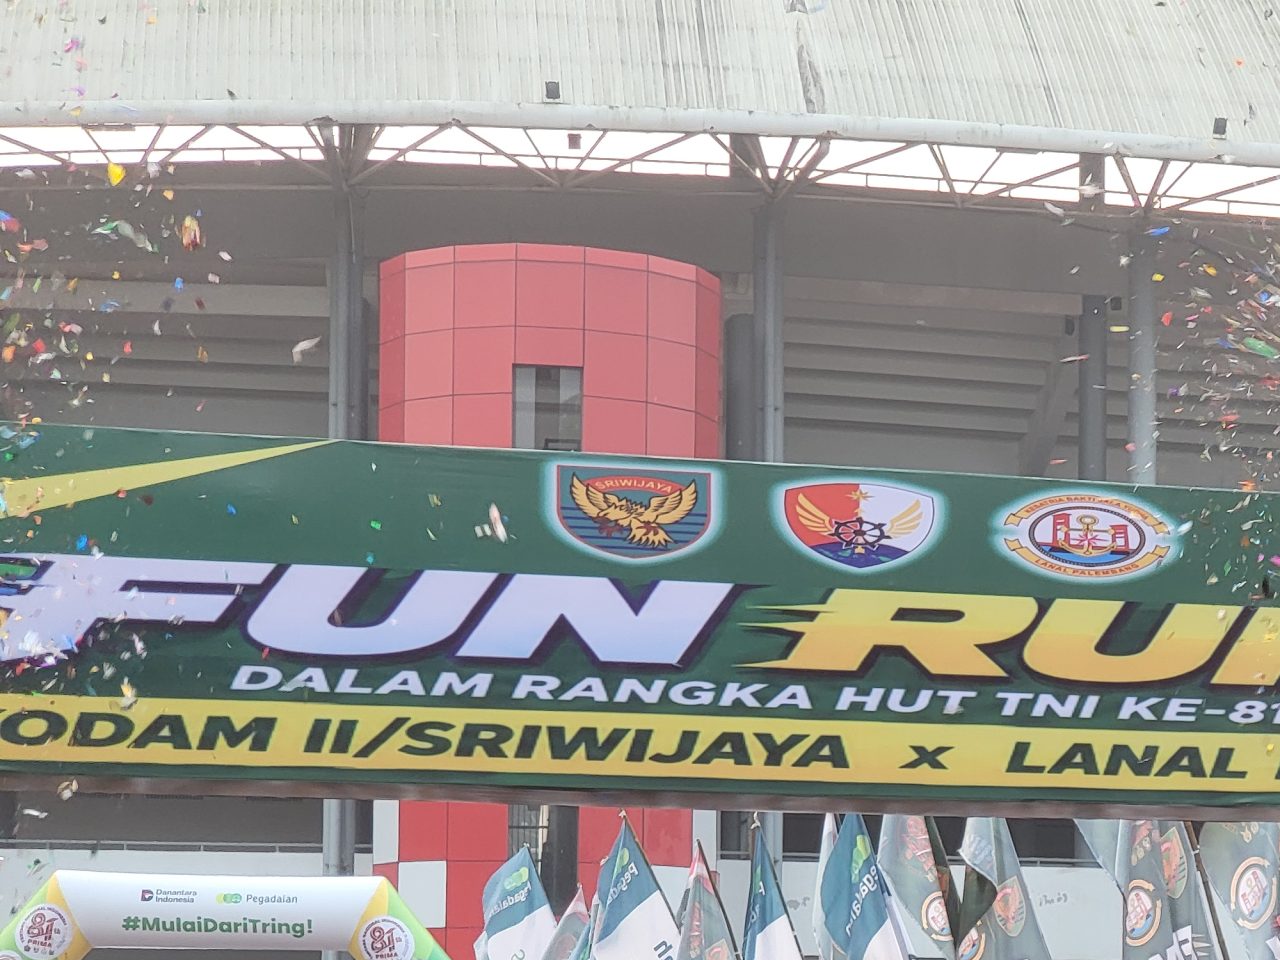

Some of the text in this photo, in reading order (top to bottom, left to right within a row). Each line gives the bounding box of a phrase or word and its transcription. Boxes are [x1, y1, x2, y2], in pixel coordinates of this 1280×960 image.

[595, 479, 673, 494] SRIWIJAYA
[1035, 559, 1140, 576] LANAL PALEMBANG
[0, 552, 735, 665] FUN
[231, 664, 490, 698] DALAM
[513, 674, 812, 711] RANGKA
[836, 685, 976, 715] HUT
[995, 691, 1102, 719] TNI
[0, 709, 278, 752] ODAM
[303, 717, 850, 769] II/SRIWIJAYA
[1006, 741, 1248, 780] LANAL
[155, 896, 195, 904] Indonesia
[156, 889, 198, 897] Danantara
[246, 894, 298, 905] Pegadaian
[122, 916, 313, 938] #MulaiDariTring!
